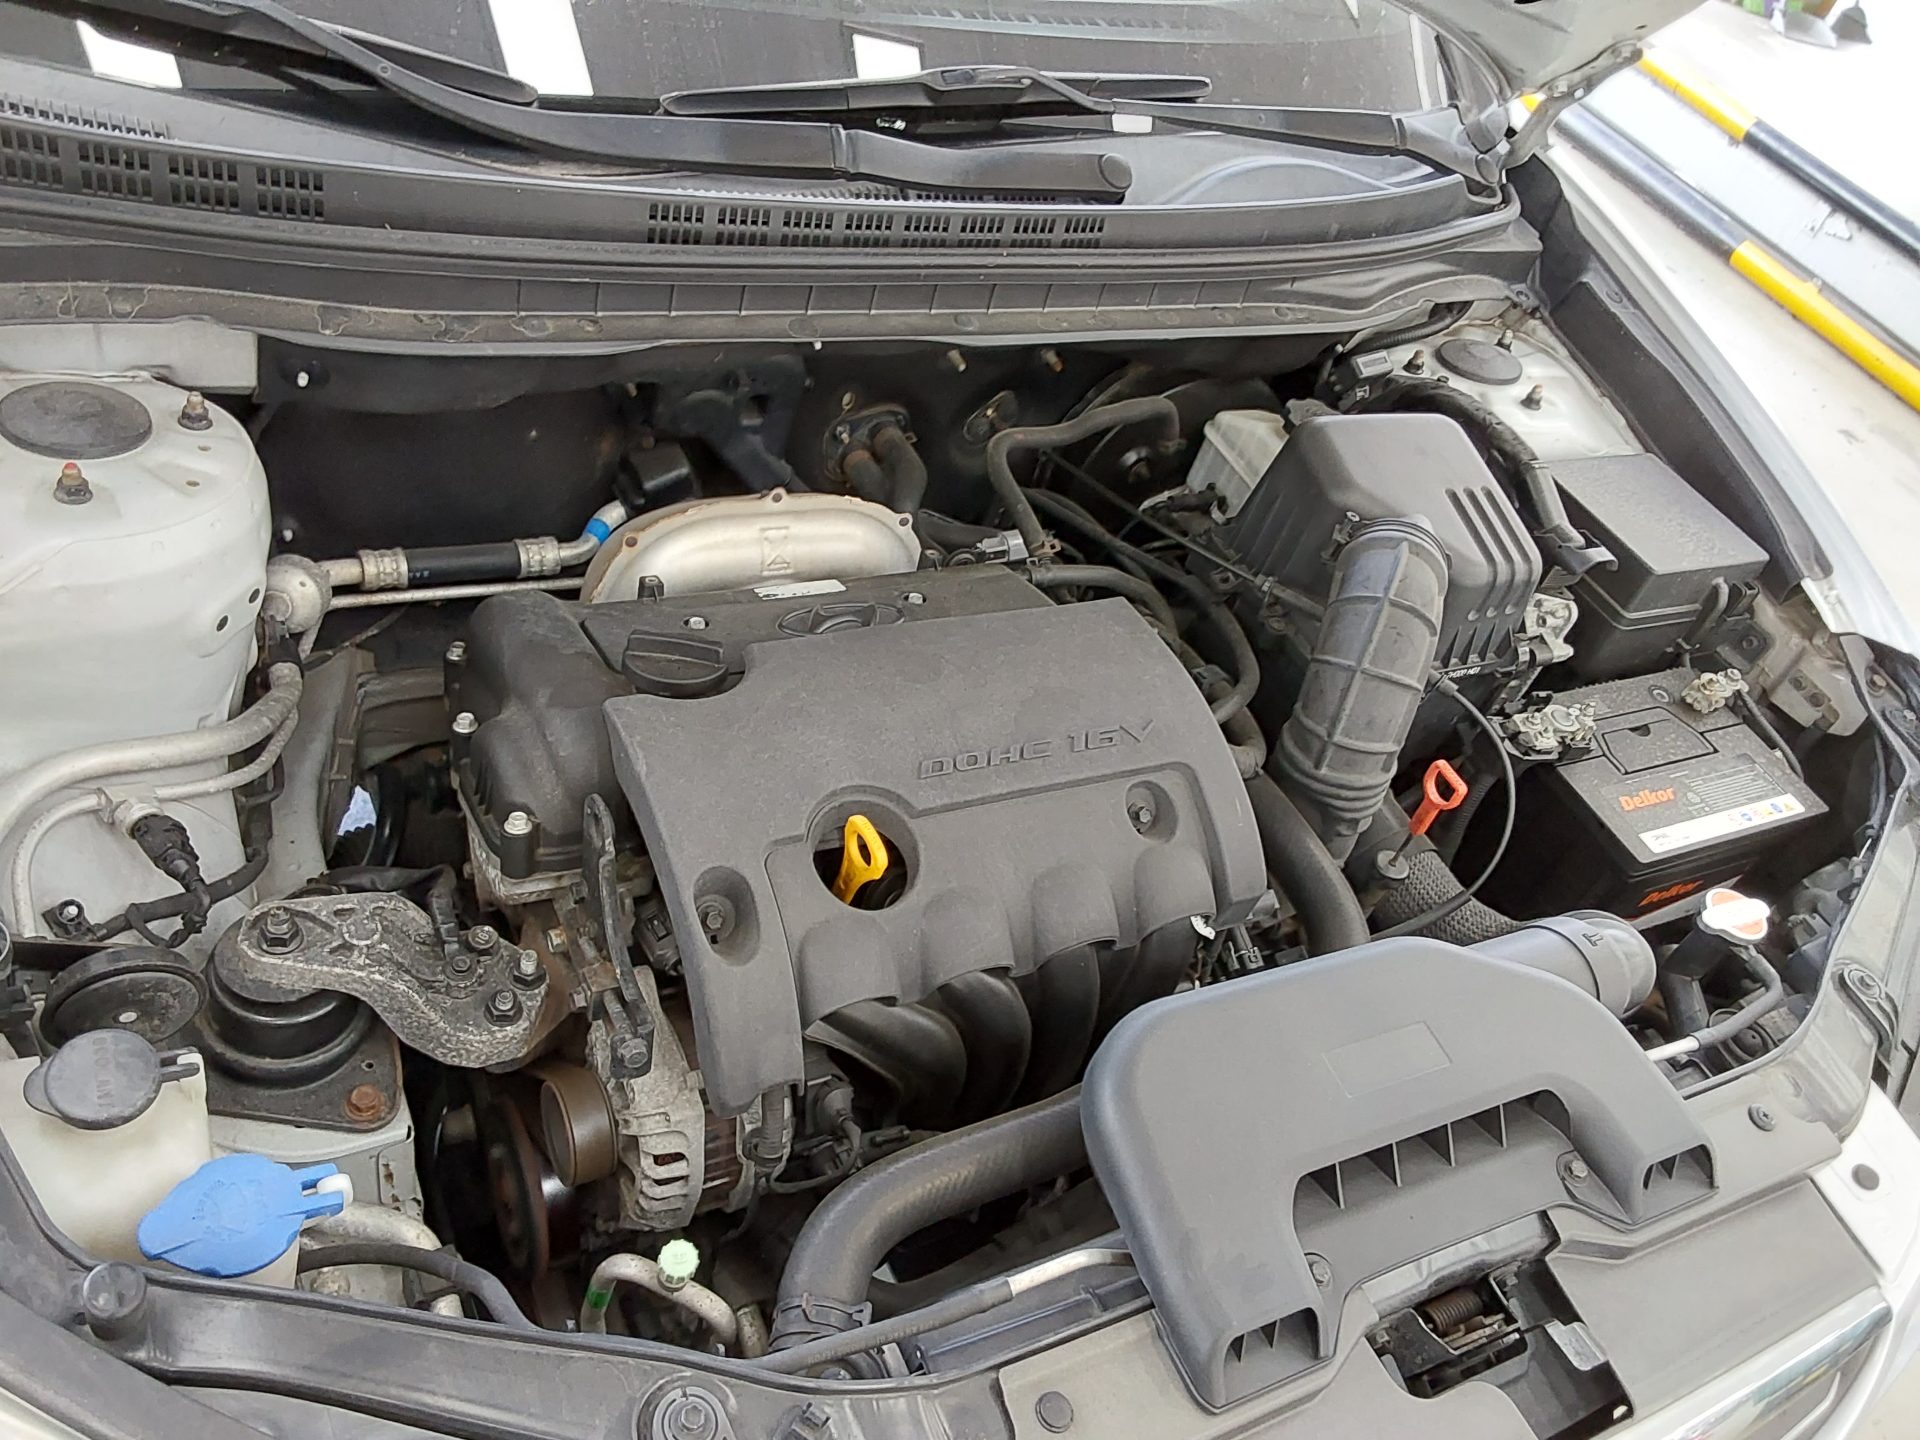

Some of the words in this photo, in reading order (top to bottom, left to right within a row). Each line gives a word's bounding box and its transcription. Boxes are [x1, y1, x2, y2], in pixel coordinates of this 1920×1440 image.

[919, 740, 1052, 779] DOHC
[1067, 718, 1154, 753] 16V
[1619, 786, 1677, 812] Delkor
